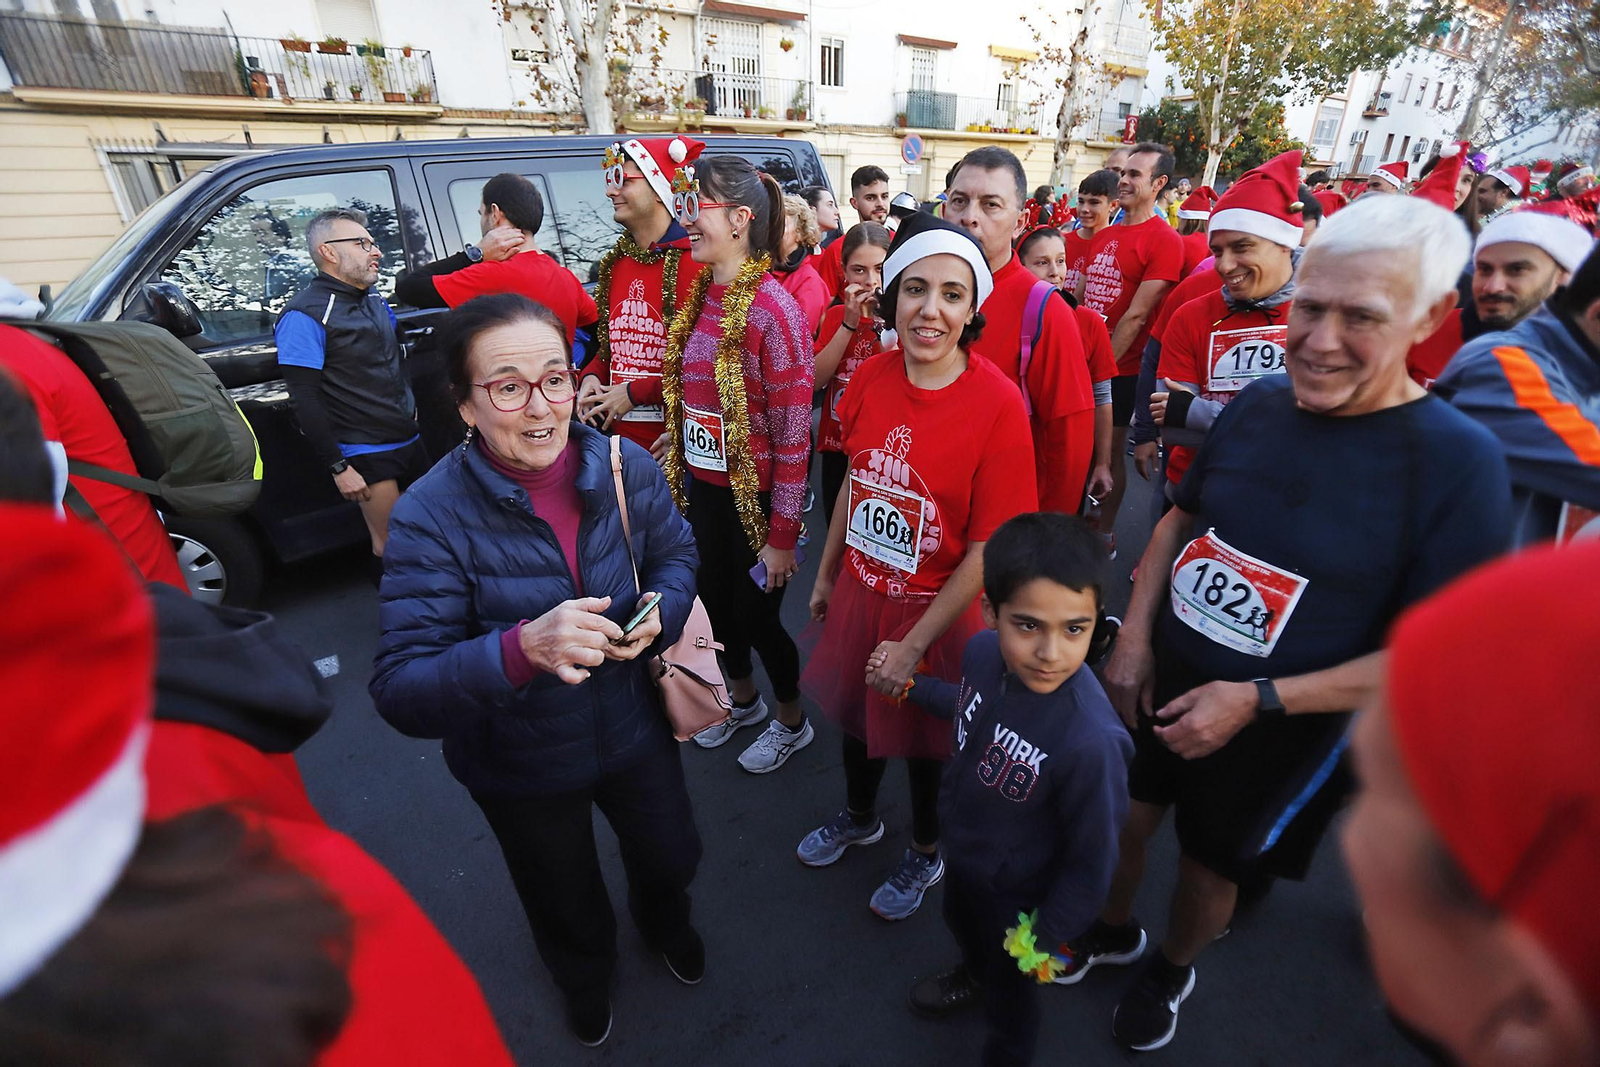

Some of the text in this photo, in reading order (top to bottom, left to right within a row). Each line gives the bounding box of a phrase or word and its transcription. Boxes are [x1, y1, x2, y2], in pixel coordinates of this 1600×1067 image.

[621, 300, 648, 317] XIII
[609, 315, 664, 337] CARRERA
[622, 331, 668, 347] SILVESTRE
[1231, 344, 1276, 370] 179
[824, 435, 842, 450] Hue
[868, 449, 910, 488] XIII
[862, 502, 900, 541] 166
[1240, 559, 1272, 577] SILVESTRE
[1192, 562, 1253, 620] 182
[993, 723, 1049, 776] YORK
[977, 741, 1040, 803] 98
